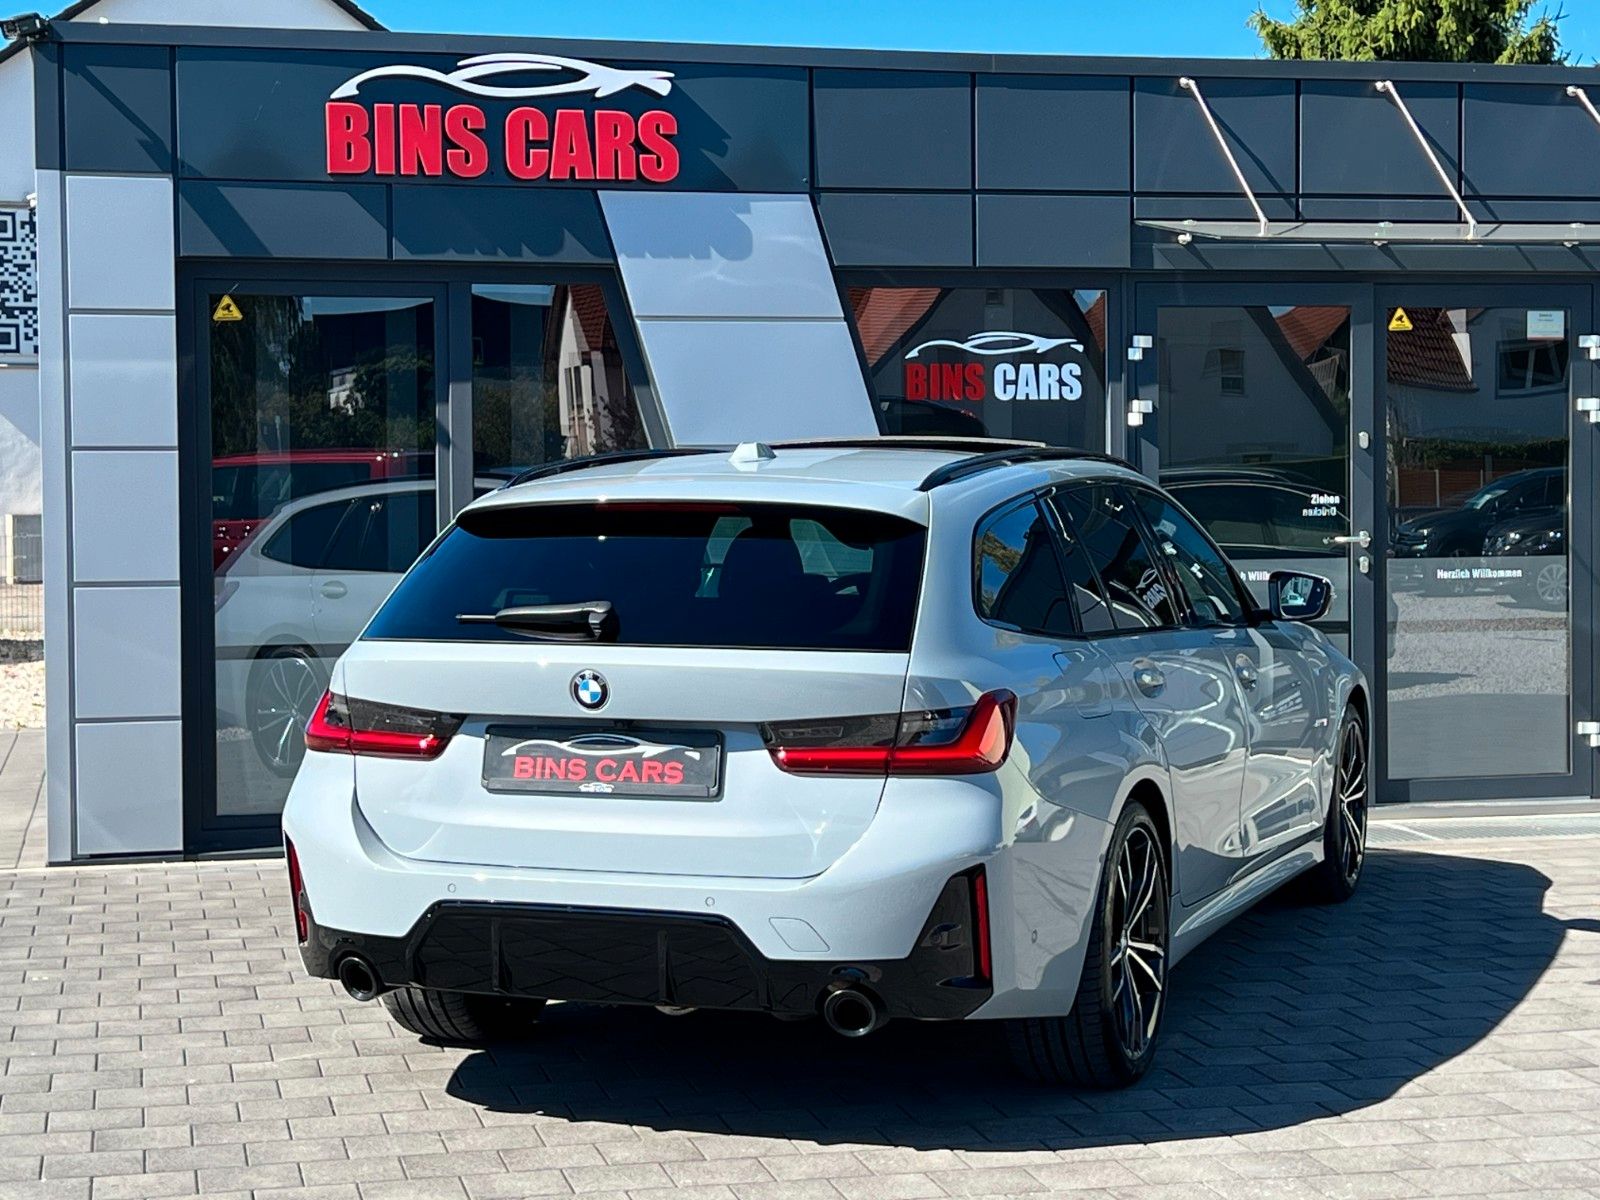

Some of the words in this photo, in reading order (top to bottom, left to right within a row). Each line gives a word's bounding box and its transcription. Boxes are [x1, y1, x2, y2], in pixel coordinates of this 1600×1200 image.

[325, 102, 489, 178] BINS
[505, 107, 681, 183] CARS
[906, 363, 986, 401] BINS
[993, 362, 1083, 401] CARS
[1310, 493, 1341, 505] Ziehen
[1436, 568, 1471, 580] Herzlich
[1471, 568, 1523, 580] Willkommen
[513, 756, 587, 781] BINS
[595, 759, 685, 785] CARS
